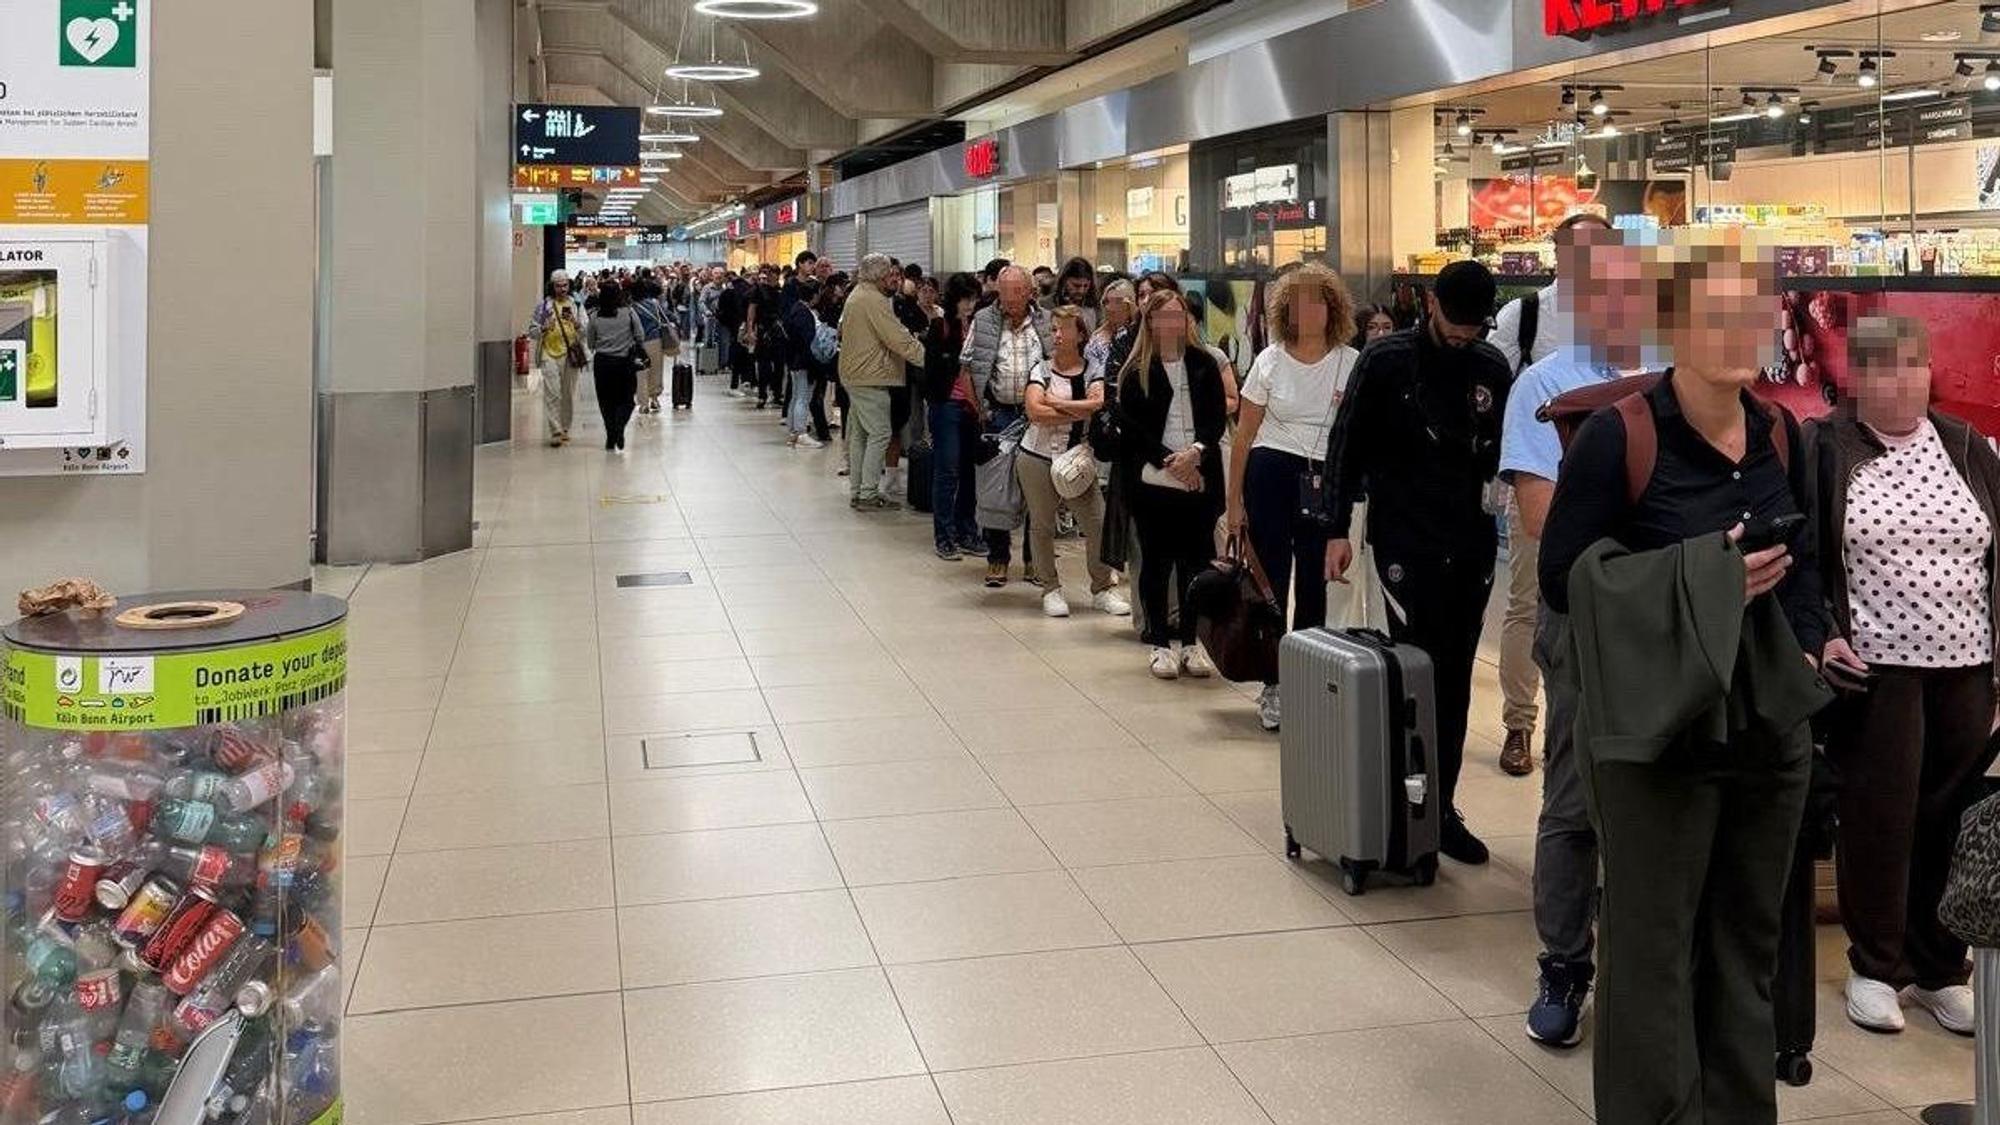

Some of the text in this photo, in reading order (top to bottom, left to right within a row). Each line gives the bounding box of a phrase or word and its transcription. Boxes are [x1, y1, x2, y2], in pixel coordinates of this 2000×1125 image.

[196, 661, 274, 688] Donate
[282, 652, 318, 679] your
[195, 694, 210, 705] to
[56, 711, 155, 725] Köln Bonn Airport
